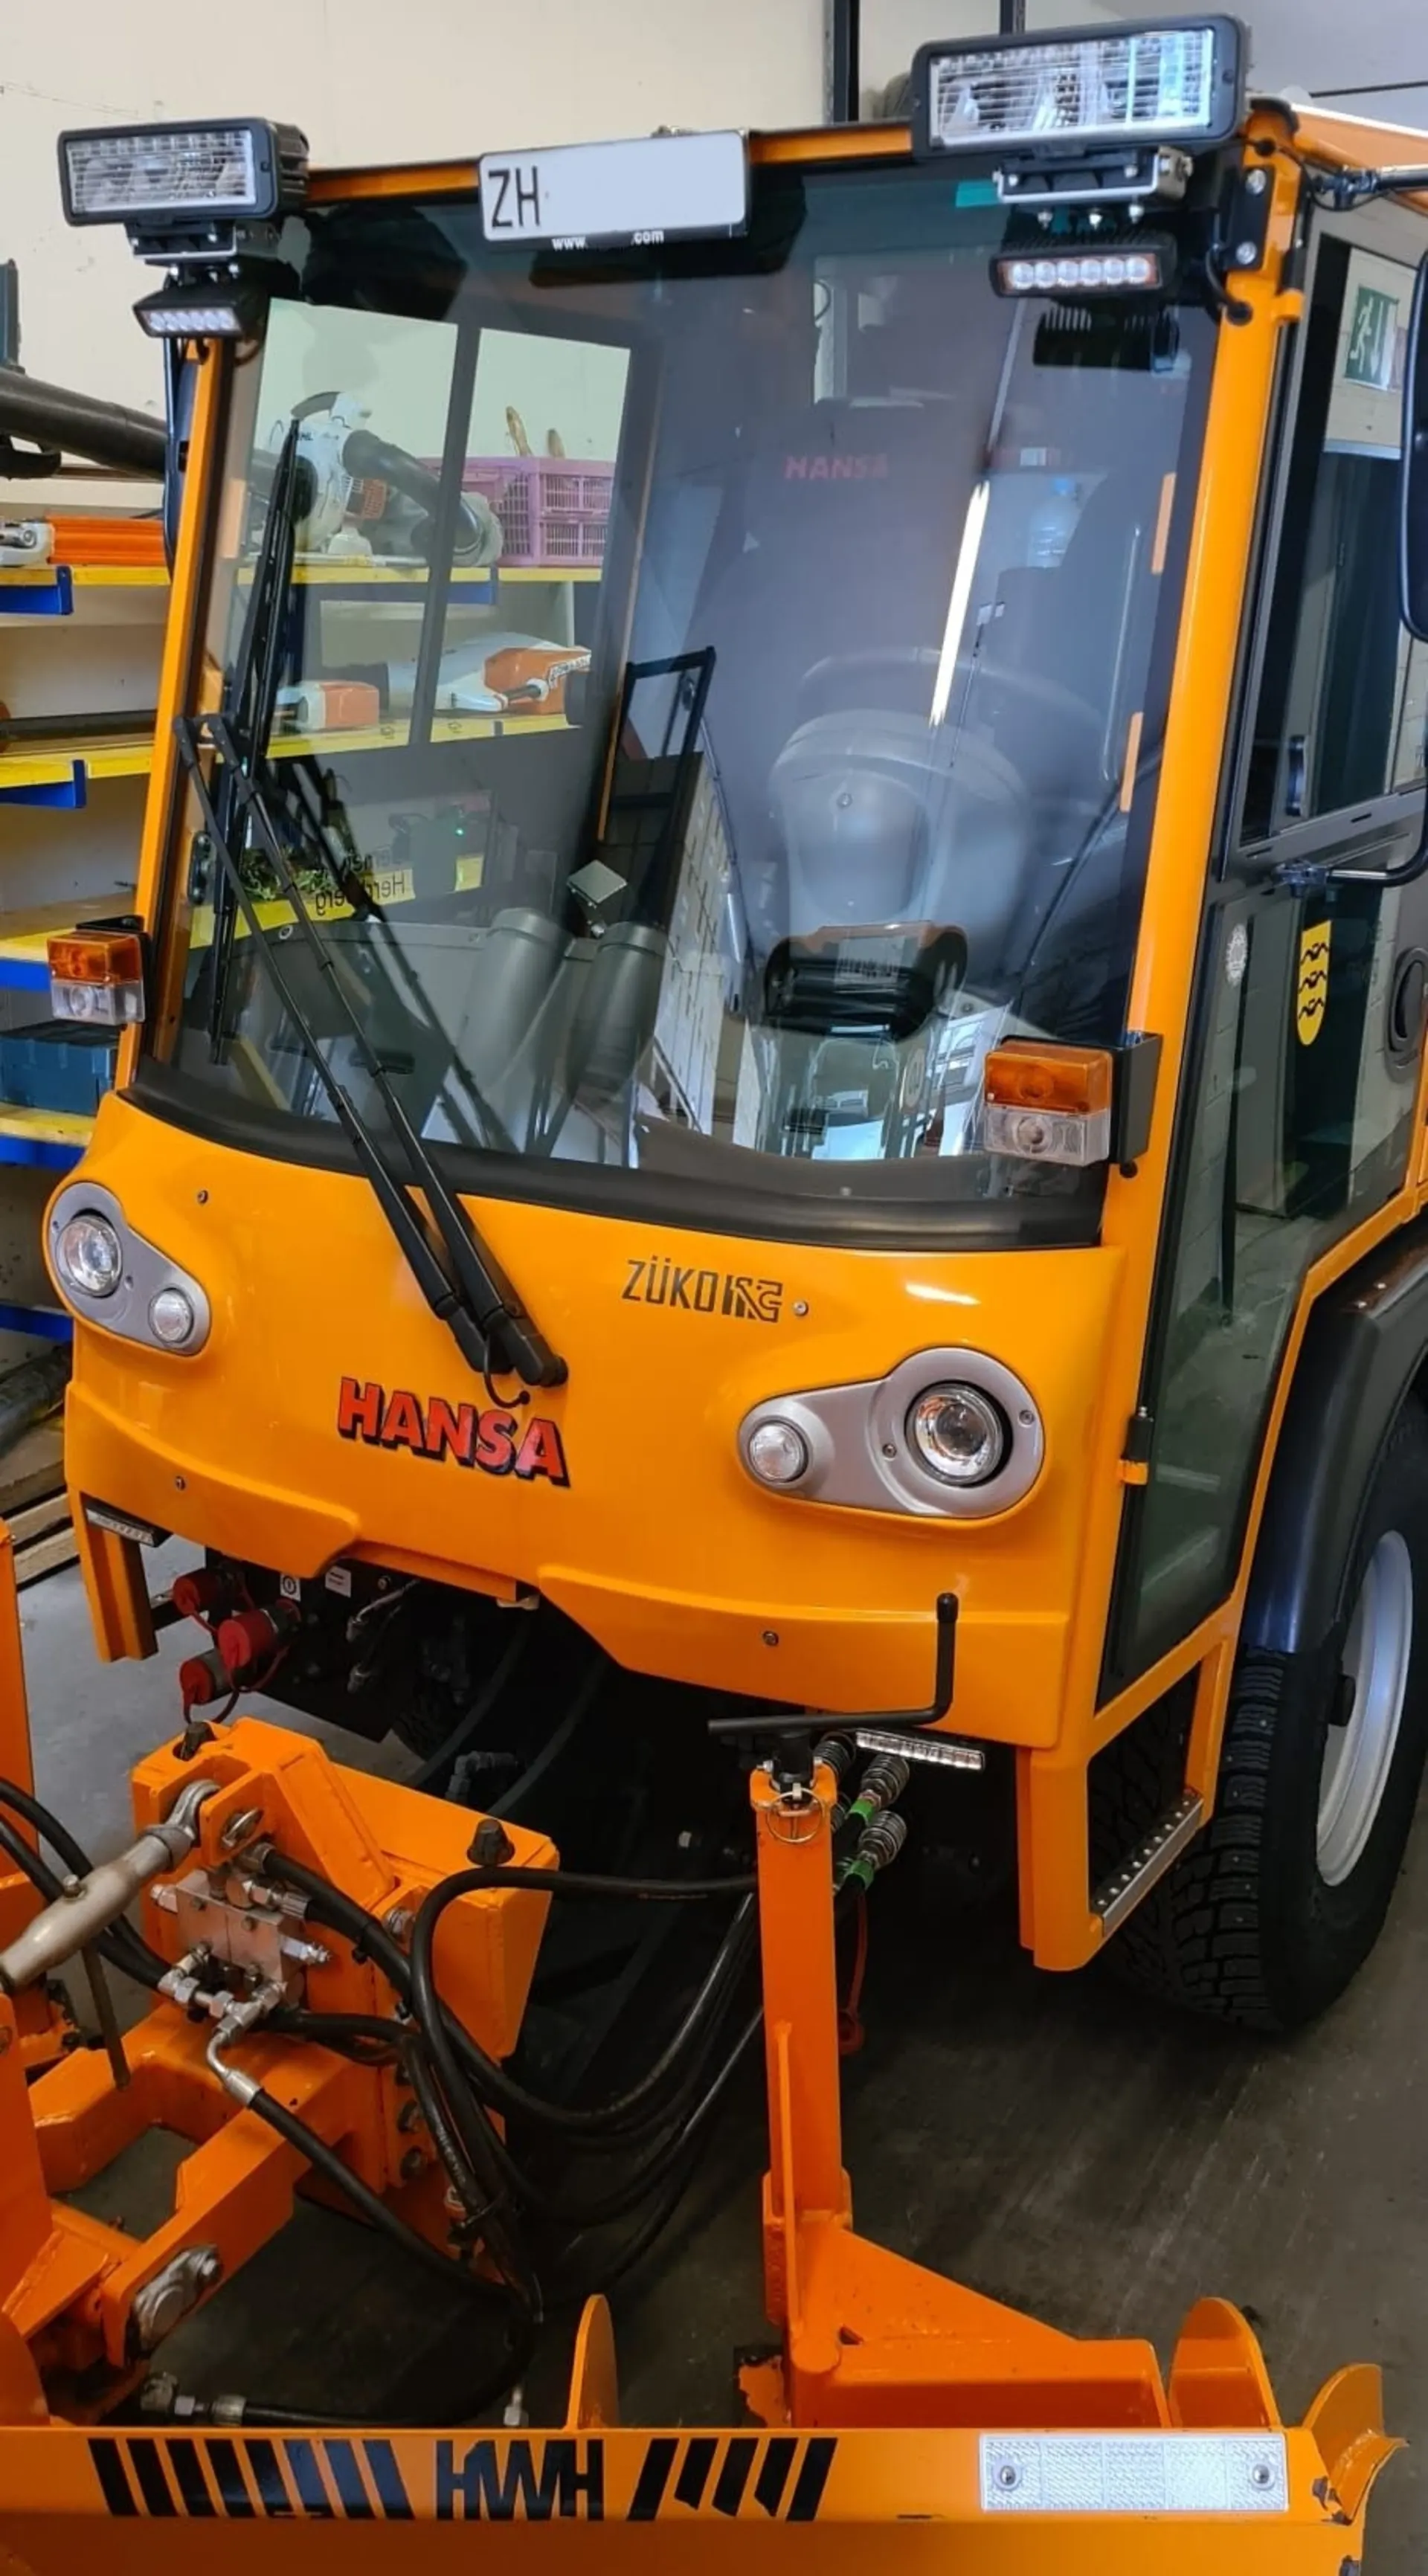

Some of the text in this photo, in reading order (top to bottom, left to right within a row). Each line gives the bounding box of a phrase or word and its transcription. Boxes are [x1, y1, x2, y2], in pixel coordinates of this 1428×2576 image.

[488, 165, 541, 229] ZH
[622, 1255, 719, 1313] ZÜKO
[338, 1376, 571, 1488] HANSA
[436, 2440, 605, 2521] HWH
